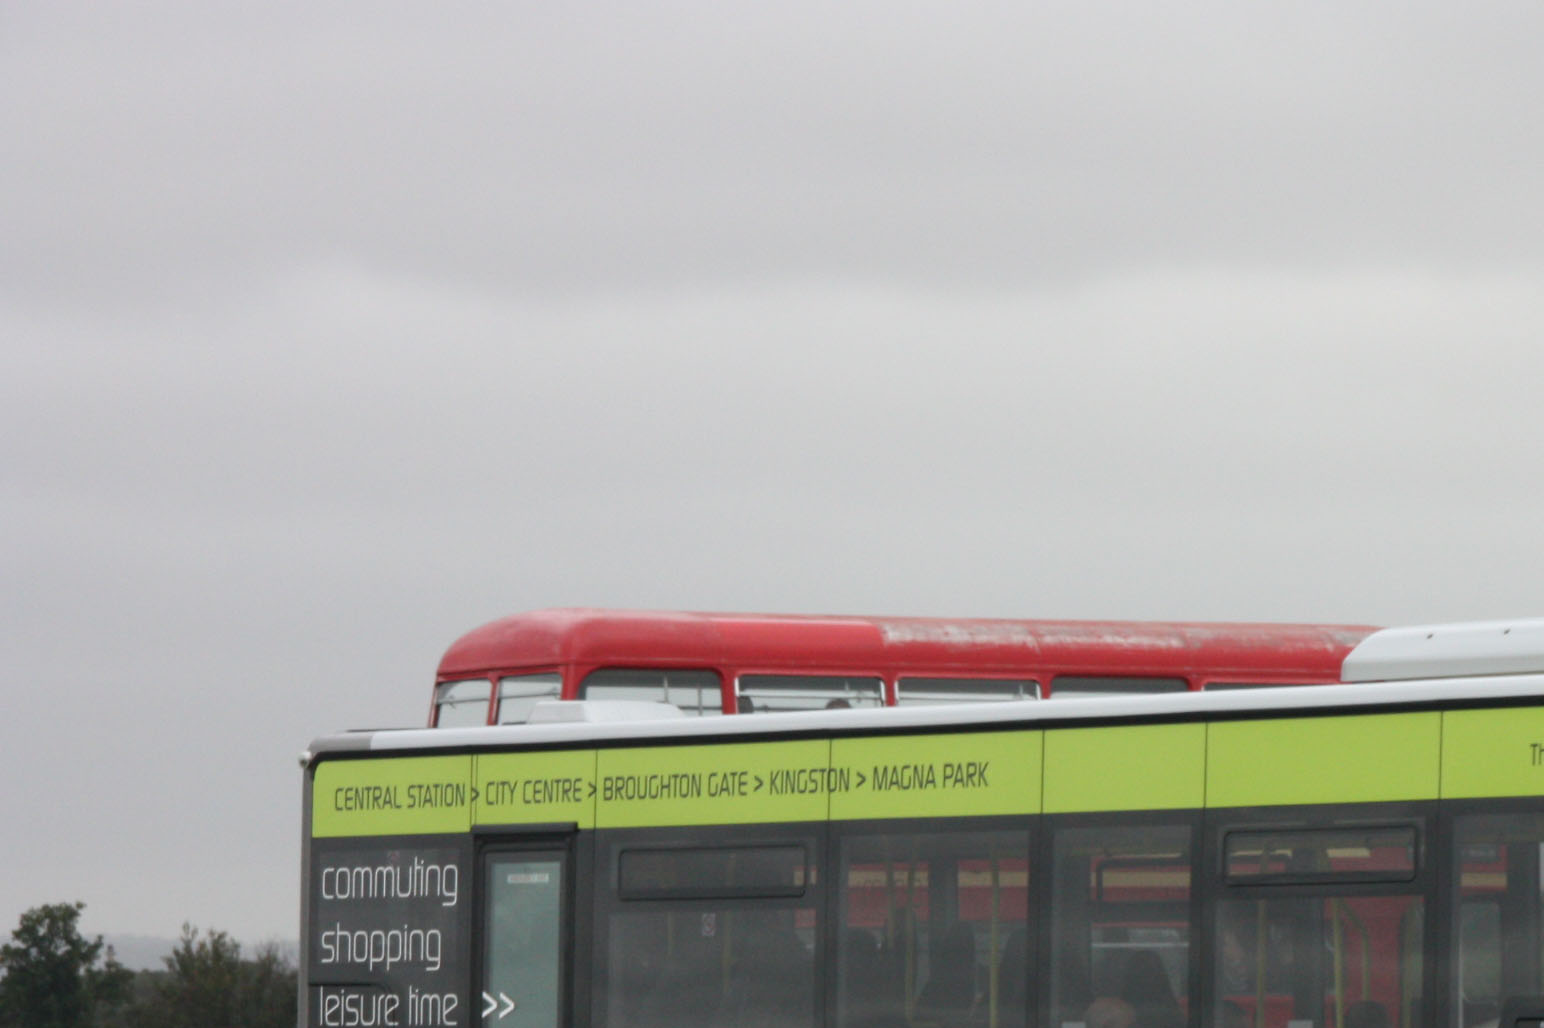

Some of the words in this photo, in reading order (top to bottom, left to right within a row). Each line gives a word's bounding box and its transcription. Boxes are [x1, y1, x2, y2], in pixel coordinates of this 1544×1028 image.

[334, 786, 402, 811] CENTRAL
[407, 783, 466, 808] STATION
[486, 781, 518, 805] CITY
[522, 778, 582, 804] CENTRE
[603, 772, 702, 801] BROUGHTON
[707, 771, 748, 798] GATE
[769, 767, 850, 795] KINGSTON
[872, 764, 936, 791] MAGNA
[944, 761, 989, 788] PARK
[322, 856, 459, 906] commuting
[321, 922, 441, 971] shopping
[320, 986, 400, 1026] leisure
[409, 984, 458, 1026] time
